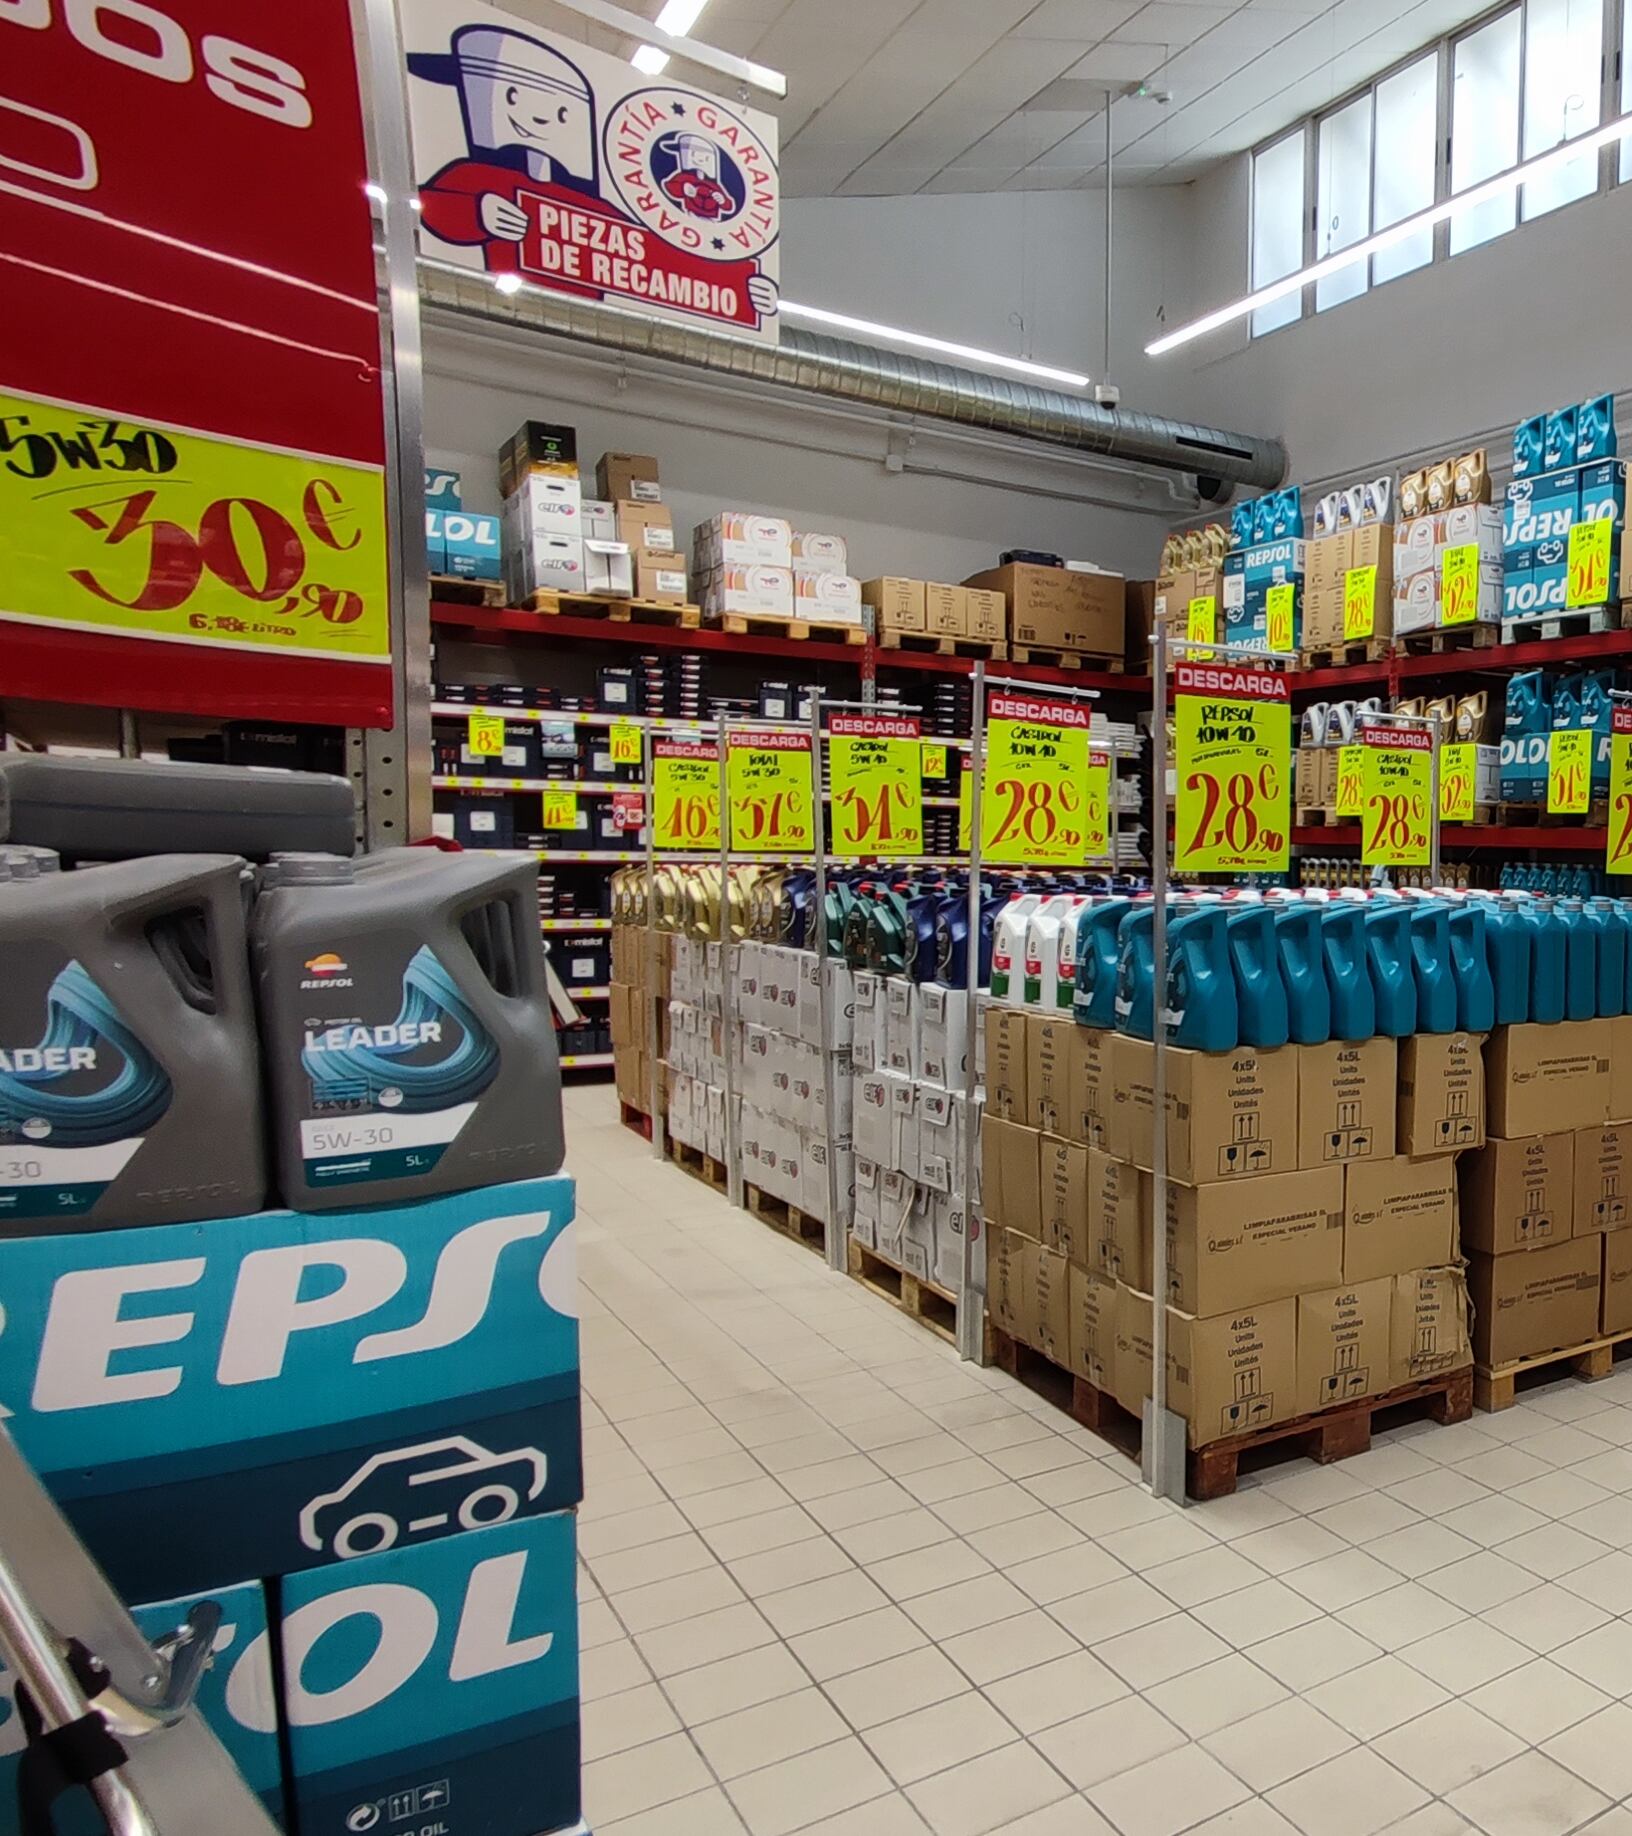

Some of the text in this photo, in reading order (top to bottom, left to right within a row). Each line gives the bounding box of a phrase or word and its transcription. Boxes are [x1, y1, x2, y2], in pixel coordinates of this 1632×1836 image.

[539, 203, 645, 262] PIEZAS
[541, 239, 737, 316] DE RECAMBIO
[1178, 668, 1287, 695] DESCARGA
[991, 699, 1087, 725] DESCARGA
[832, 719, 918, 735] DESCARGA
[1366, 730, 1430, 747] DESCARGA
[731, 734, 808, 748] DESCARGA
[300, 978, 354, 989] REPSOL
[304, 1021, 442, 1052] LEADER
[312, 1127, 393, 1150] 5W-30
[405, 1155, 423, 1167] 5L
